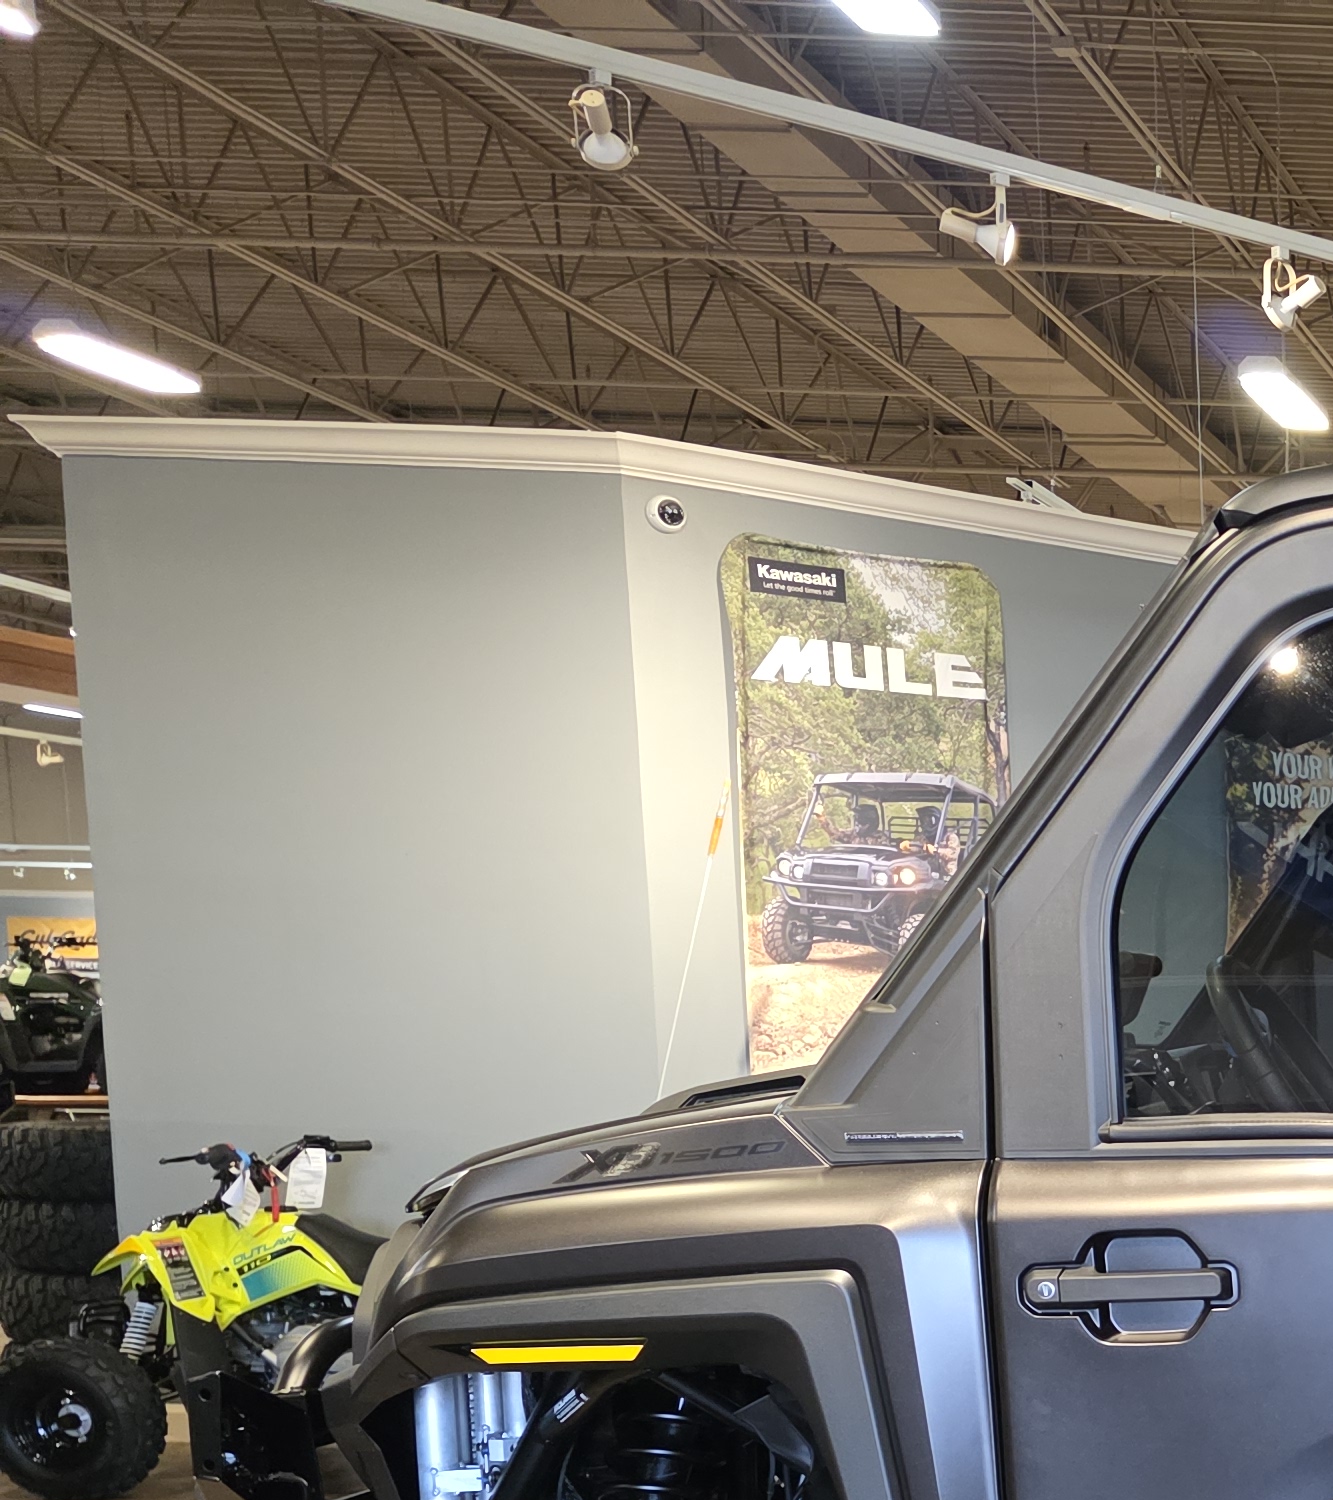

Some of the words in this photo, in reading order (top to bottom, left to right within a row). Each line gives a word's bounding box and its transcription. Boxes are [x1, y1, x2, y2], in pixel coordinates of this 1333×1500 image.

[757, 563, 837, 588] Kawasaki
[763, 581, 774, 589] Let
[805, 587, 822, 595] times
[750, 636, 987, 700] MULE
[1270, 750, 1322, 779] YOUR
[1252, 781, 1303, 809] YOUR
[659, 1140, 788, 1166] 1500
[233, 1233, 297, 1266] OUTLAW
